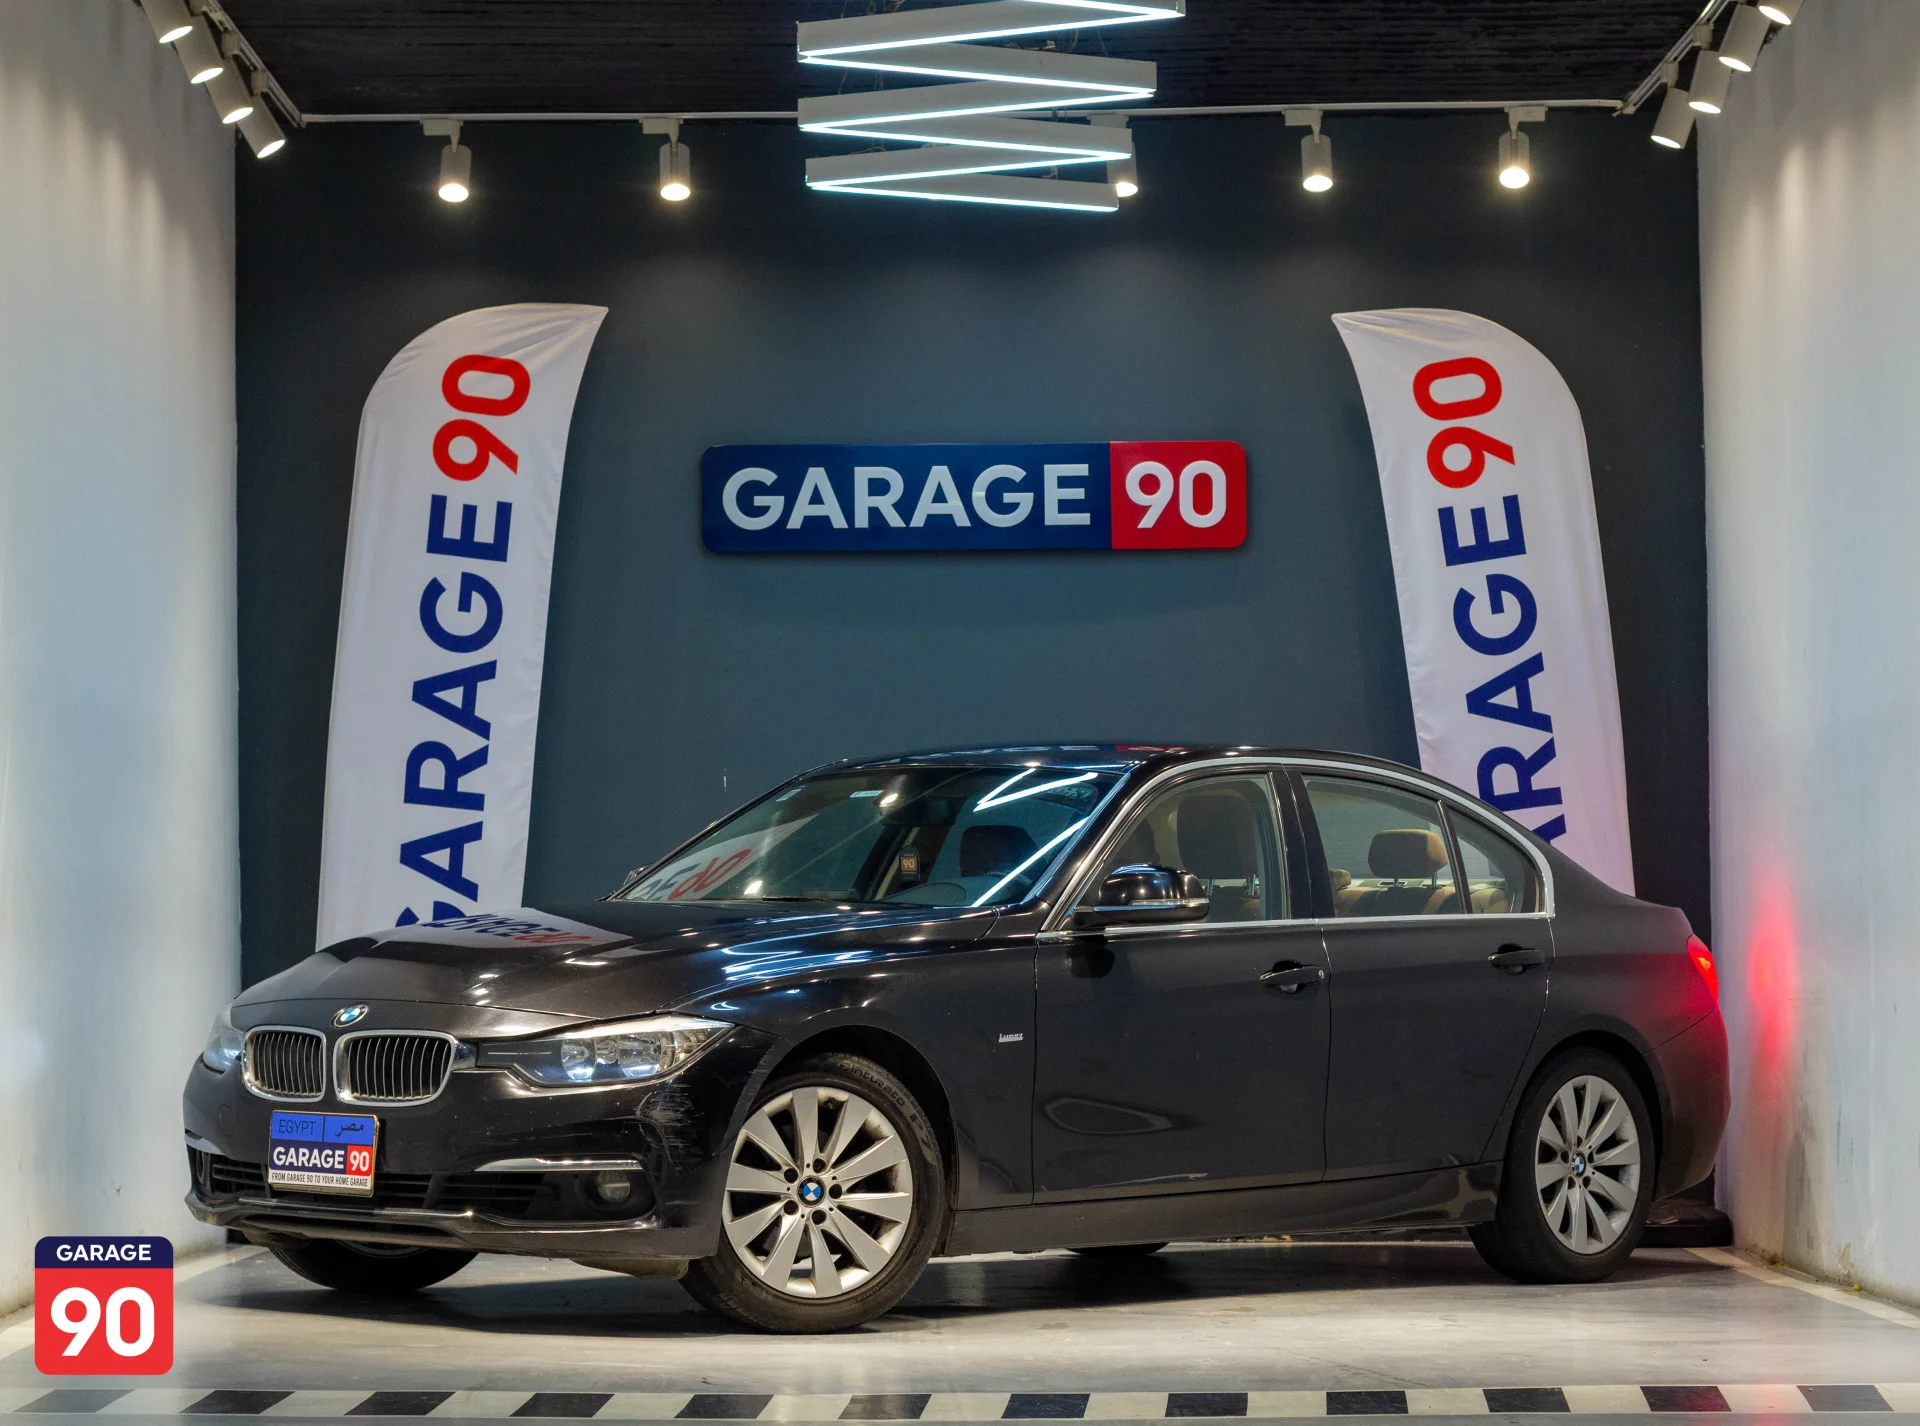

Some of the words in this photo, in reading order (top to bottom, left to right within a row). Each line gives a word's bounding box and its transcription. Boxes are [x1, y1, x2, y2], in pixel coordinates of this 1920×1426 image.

[432, 354, 531, 482] 90
[1412, 357, 1516, 489] 90
[722, 464, 1091, 531] GARAGE
[1125, 460, 1227, 529] 90
[1438, 494, 1566, 844] RAGE
[395, 494, 512, 928] ARAGE
[903, 859, 915, 868] 90
[278, 1119, 317, 1135] EGYPT
[334, 1122, 365, 1138] مصر
[271, 1172, 286, 1181] FROM
[286, 1173, 306, 1183] GARAGE
[306, 1175, 314, 1183] 90
[321, 1176, 335, 1185] YOUR
[335, 1177, 349, 1185] HOME
[349, 1178, 368, 1187] GARAGE
[273, 1146, 345, 1169] GARAGE
[349, 1150, 371, 1172] 90
